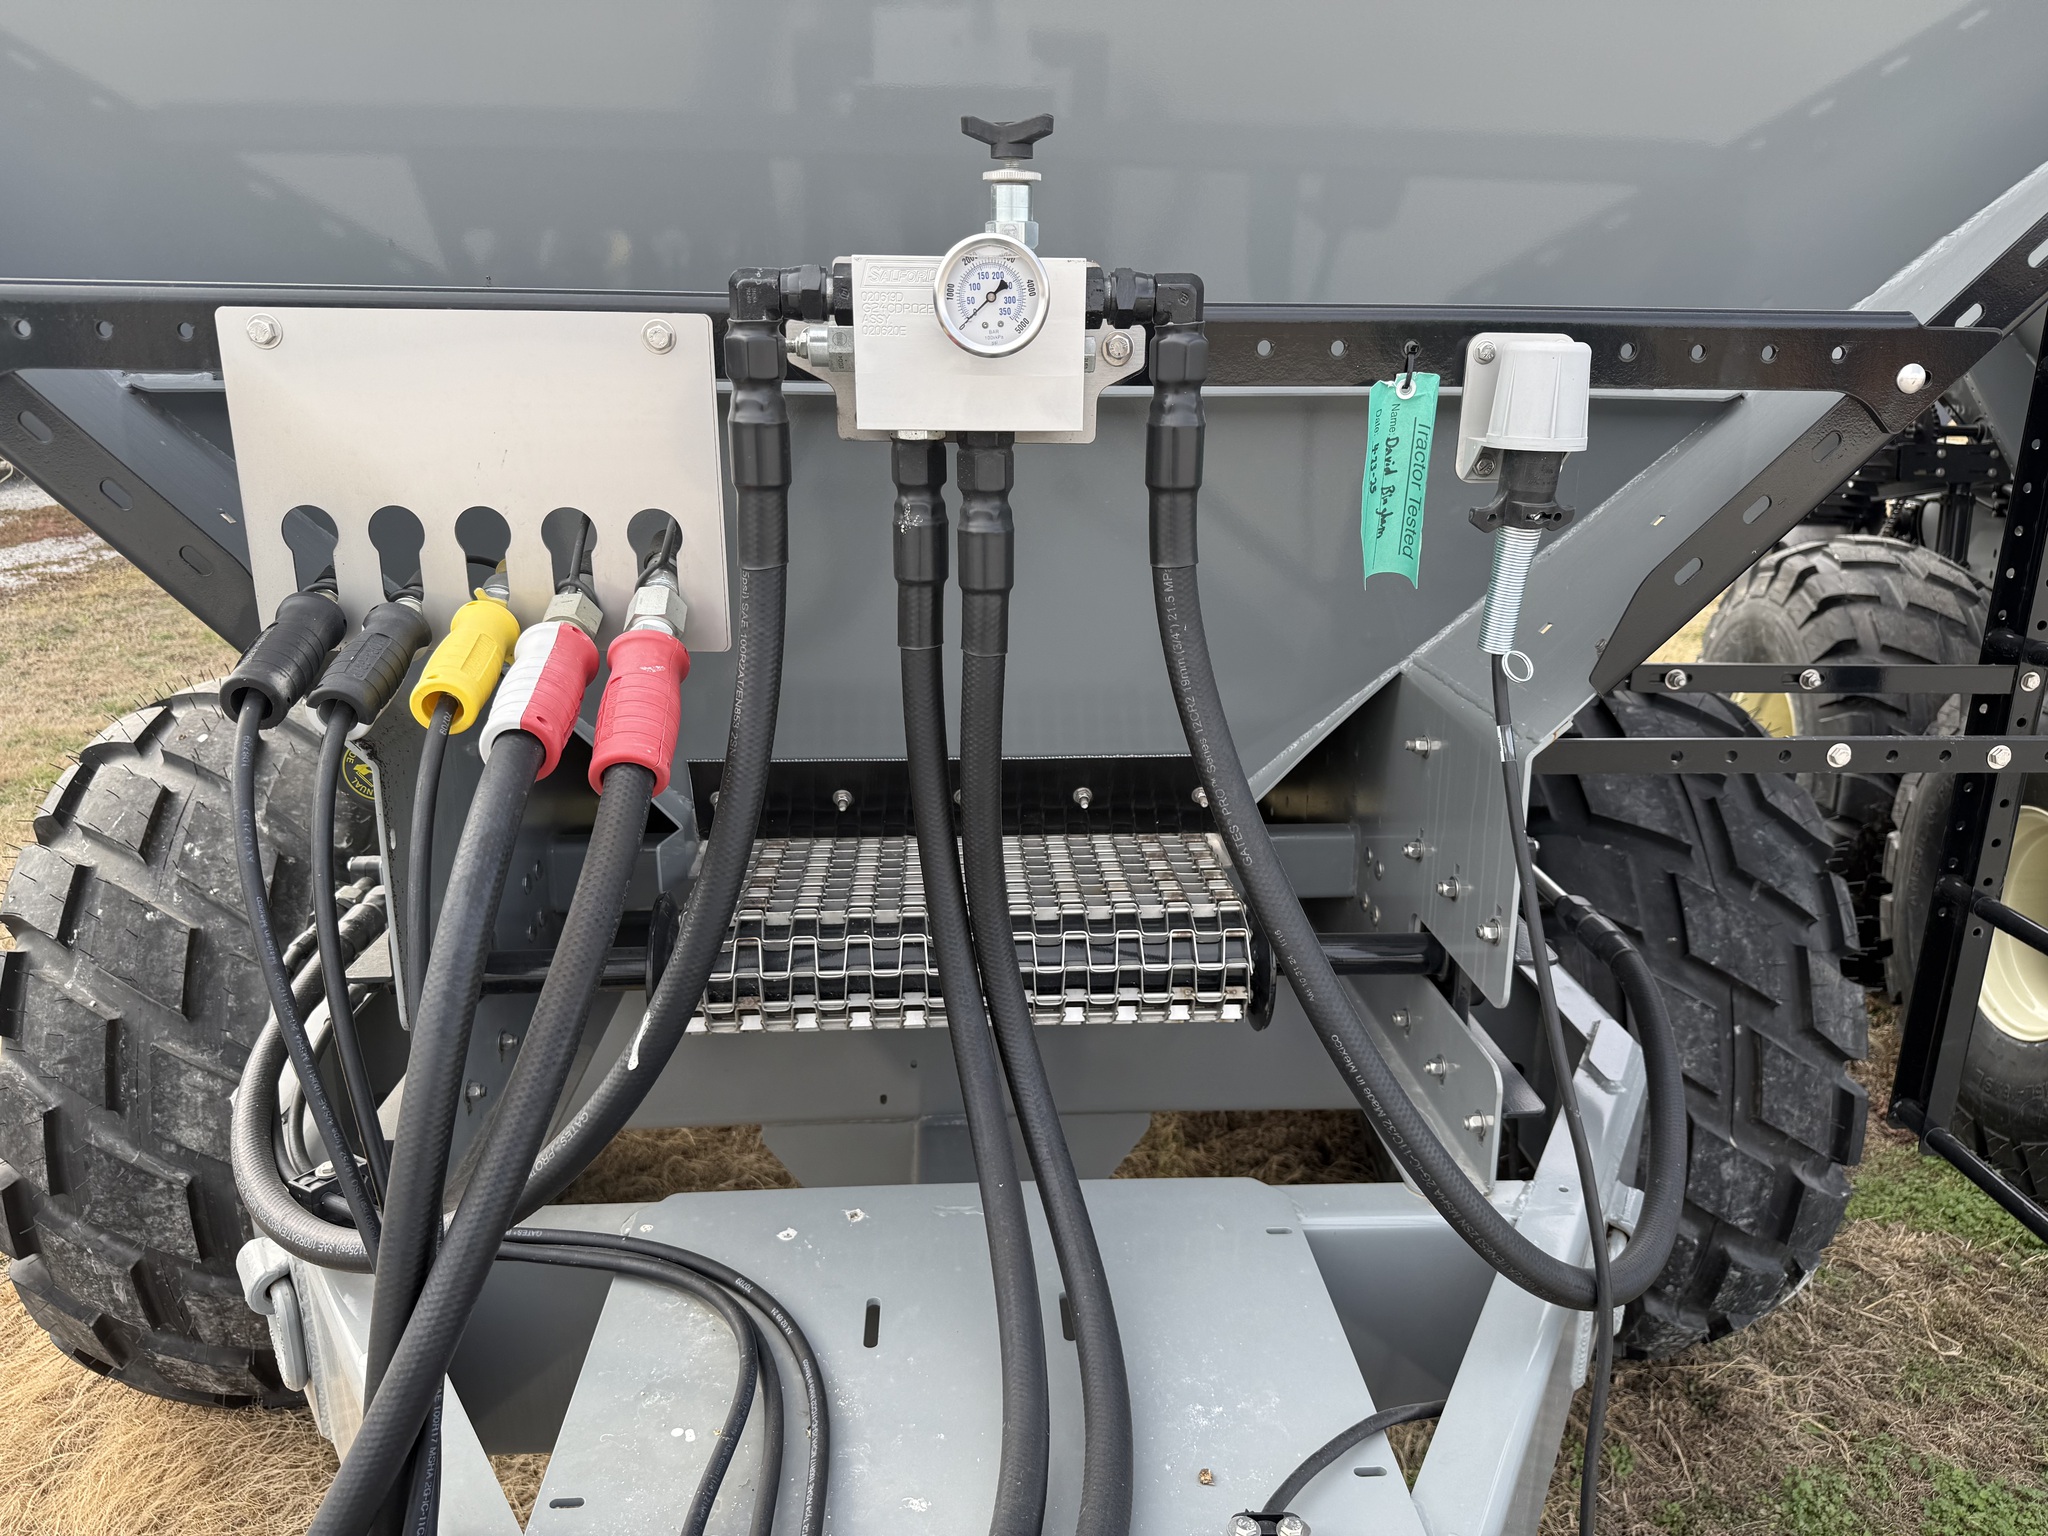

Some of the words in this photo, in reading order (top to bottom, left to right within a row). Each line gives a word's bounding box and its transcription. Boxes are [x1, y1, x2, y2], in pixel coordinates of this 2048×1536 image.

[868, 265, 939, 283] SALFORD
[977, 271, 990, 280] 150
[991, 271, 1005, 280] 200
[946, 283, 955, 301] 1000
[969, 282, 981, 291] 100
[1026, 279, 1037, 297] 4000
[966, 296, 976, 305] 50
[998, 307, 1012, 316] 350
[1003, 296, 1017, 305] 300
[861, 313, 893, 324] ASSY.
[1014, 317, 1030, 334] 5000
[1373, 409, 1383, 437] Date:
[1388, 403, 1400, 436] Name:
[1383, 436, 1399, 475] David
[1411, 423, 1431, 491] Tractor
[1401, 496, 1422, 560] Tested
[740, 602, 749, 627] SAE
[1165, 595, 1177, 621] 21.5
[731, 632, 748, 728] 100R2AT/EN853
[1175, 657, 1192, 691] 19mm
[438, 710, 452, 735] 70709
[1184, 695, 1204, 734] 12CR2
[240, 734, 252, 767] 108739
[1198, 737, 1217, 773] Series
[351, 777, 374, 796] NUAL
[241, 808, 249, 819] 23
[242, 835, 252, 845] 12
[244, 848, 255, 863] AX
[253, 895, 269, 928] Mexico
[261, 929, 270, 938] in
[264, 939, 278, 965] Made
[293, 1033, 310, 1062] MSHA
[1329, 1032, 1358, 1075] Mexico
[304, 1062, 323, 1096] 100R17
[1353, 1073, 1366, 1086] in
[1361, 1085, 1387, 1119] Made
[329, 1126, 345, 1149] Type
[337, 1149, 356, 1177] 18752
[350, 1178, 363, 1196] ISO
[1433, 1186, 1461, 1219] MSHA
[1457, 1217, 1479, 1239] 2SN
[317, 1240, 334, 1253] SAE
[734, 1276, 753, 1293] 70709
[774, 1312, 784, 1322] 09
[779, 1318, 789, 1328] 02
[784, 1325, 794, 1335] AX
[800, 1357, 812, 1377] Mexico
[430, 1405, 441, 1442] 100R17
[424, 1445, 438, 1479] MSHA
[415, 1480, 433, 1536] 2G-IC-11C
